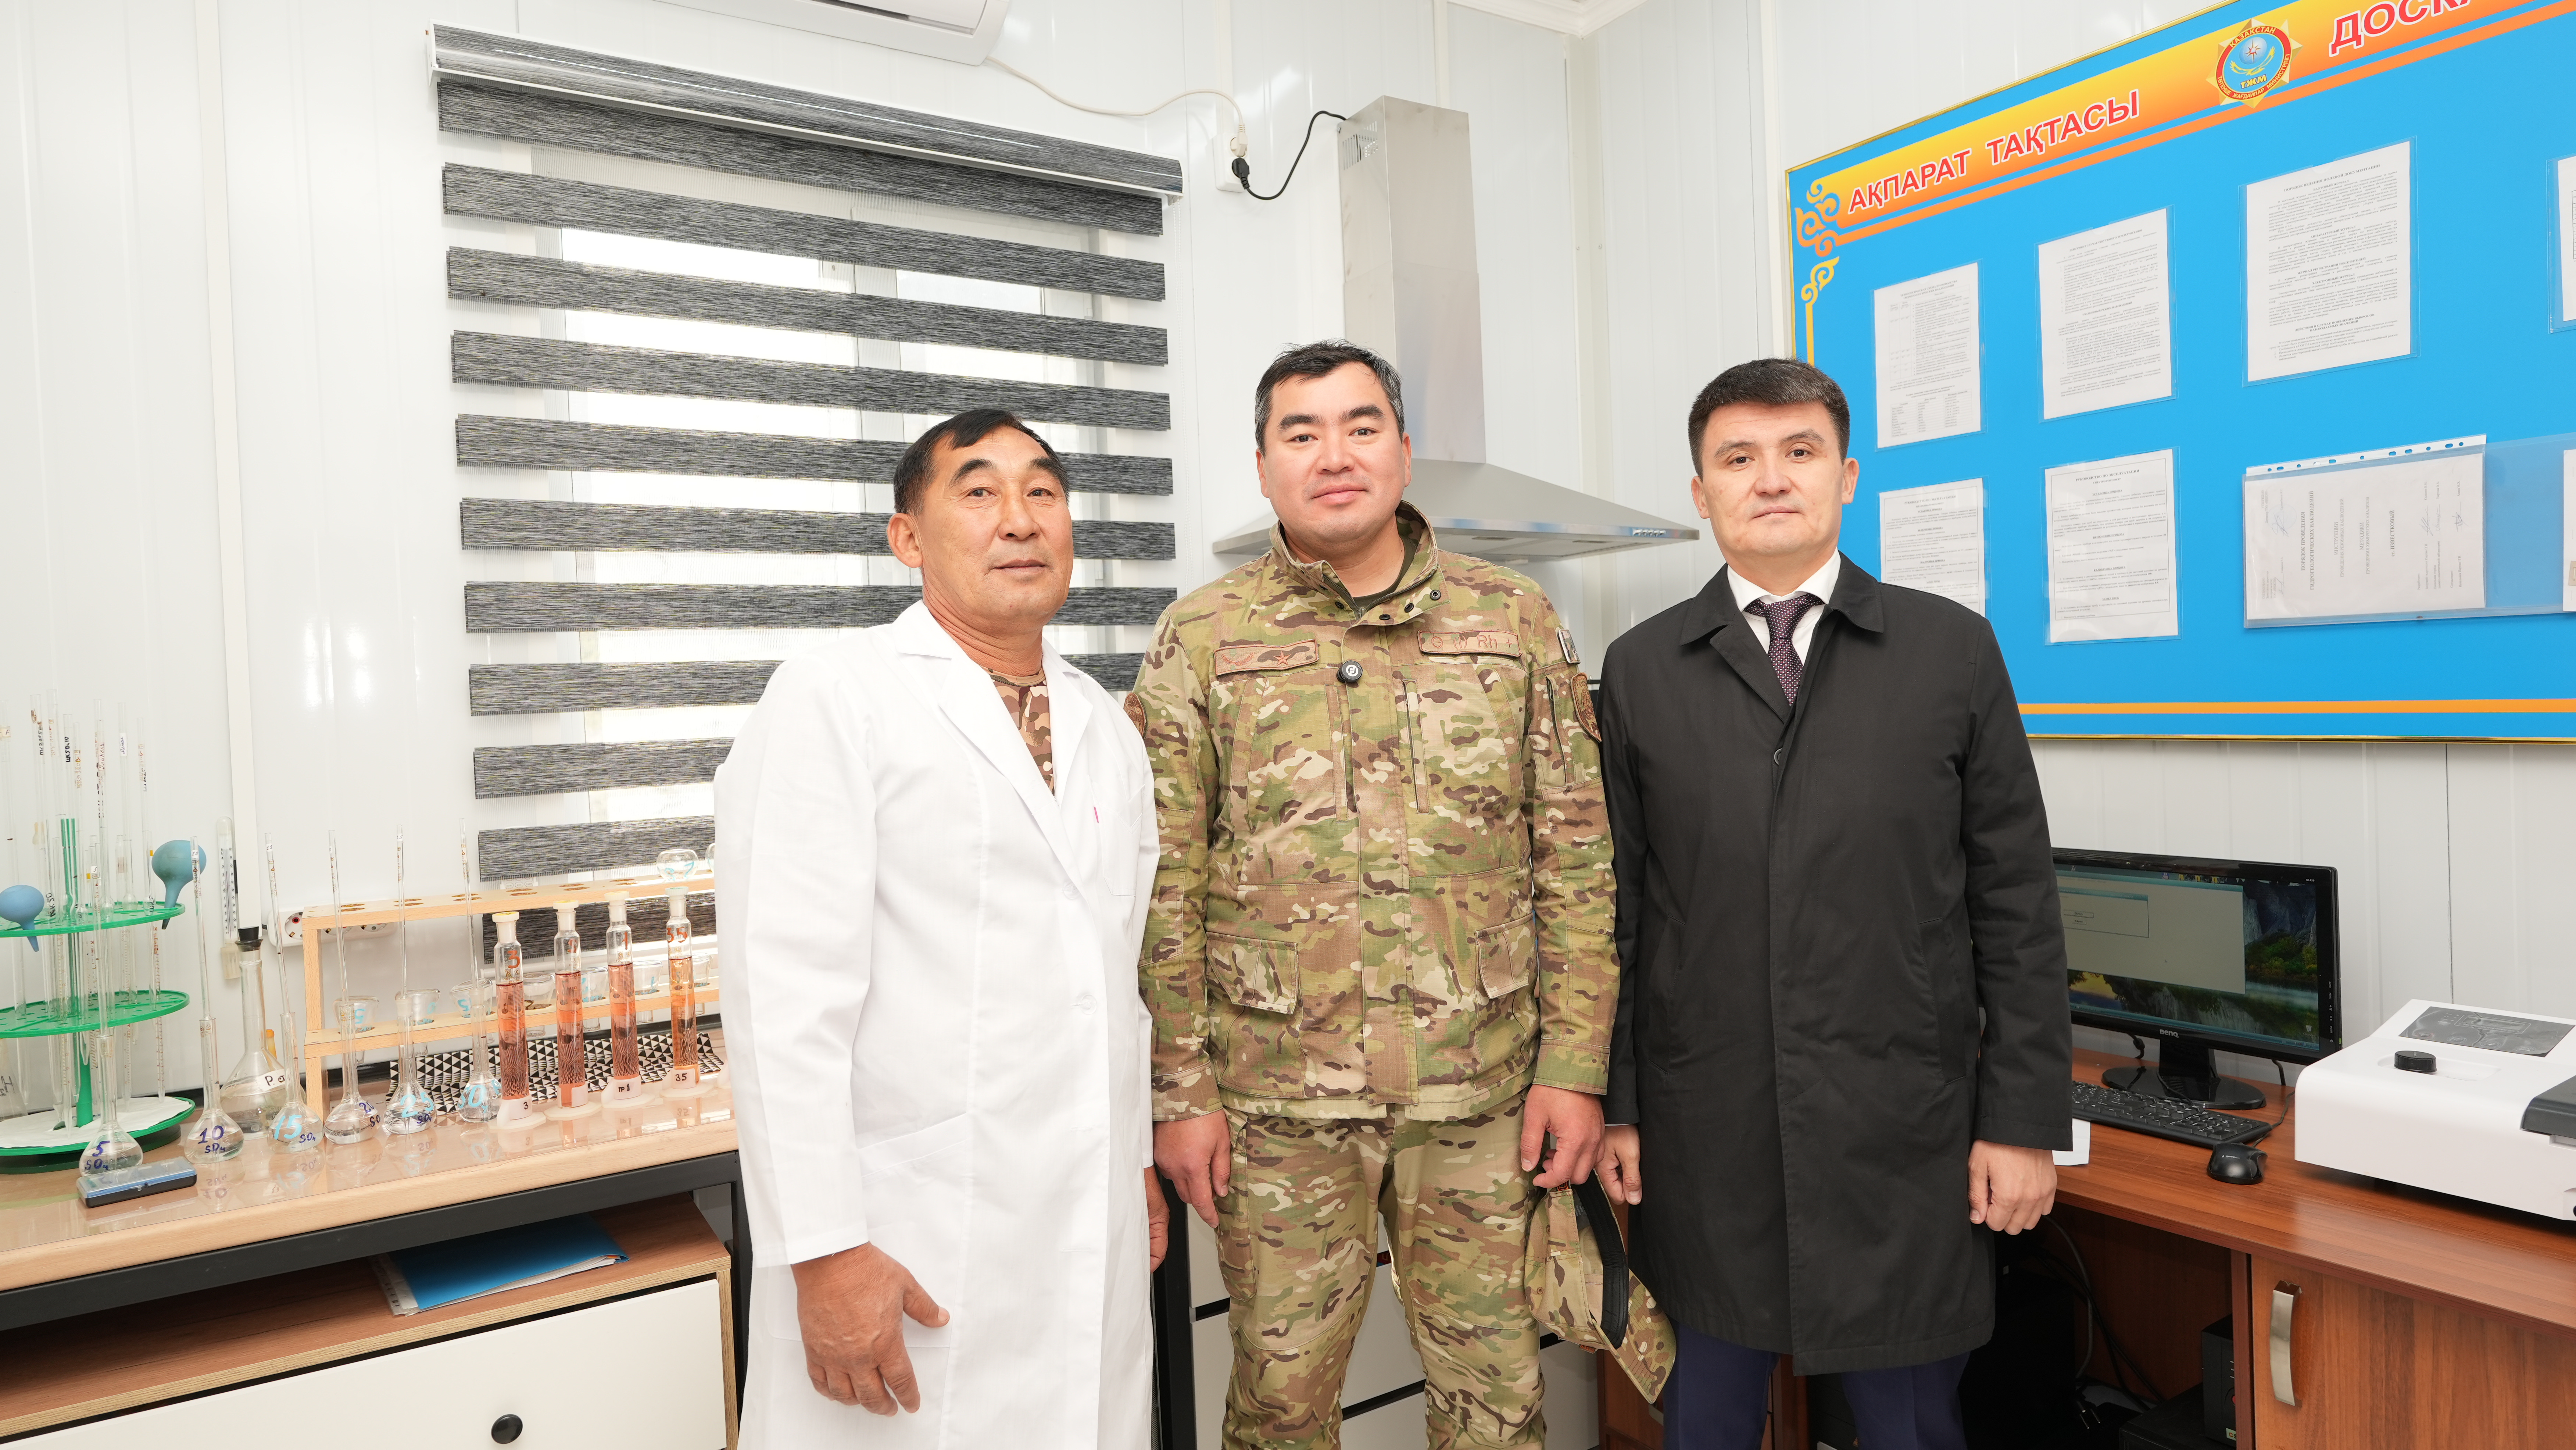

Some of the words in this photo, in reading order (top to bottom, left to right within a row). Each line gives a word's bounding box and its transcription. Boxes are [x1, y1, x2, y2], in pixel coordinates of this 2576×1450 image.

[2217, 75, 2232, 96] ТӨТЕНШЕ
[2232, 88, 2265, 99] ЖАҒДАЙЛАР
[2266, 54, 2290, 89] МИНИСТРЛІГІ
[2240, 74, 2267, 89] ТЖМ
[1848, 149, 1971, 213] АҚПАРАТ
[1986, 89, 2139, 164] ТАҚТАСЫ
[2284, 184, 2303, 192] ПОРЯДОК
[2304, 179, 2322, 187] ВЕДЕНИЯ
[2323, 174, 2343, 182] ПОЛЕВОЙ
[2344, 164, 2380, 176] ДОКУМЕНТАЦИИ
[2109, 469, 2139, 477] ЭКСПЛУАТАЦИИ
[1477, 635, 1498, 649] Rh
[666, 927, 688, 943] 35
[507, 950, 520, 969] 3
[2160, 1029, 2179, 1038] BenQ
[675, 1073, 688, 1082] 35
[399, 1092, 434, 1118] 25
[523, 1101, 529, 1110] 3
[198, 1125, 225, 1144] 10
[273, 1114, 302, 1140] 15
[92, 1140, 110, 1157] 5
